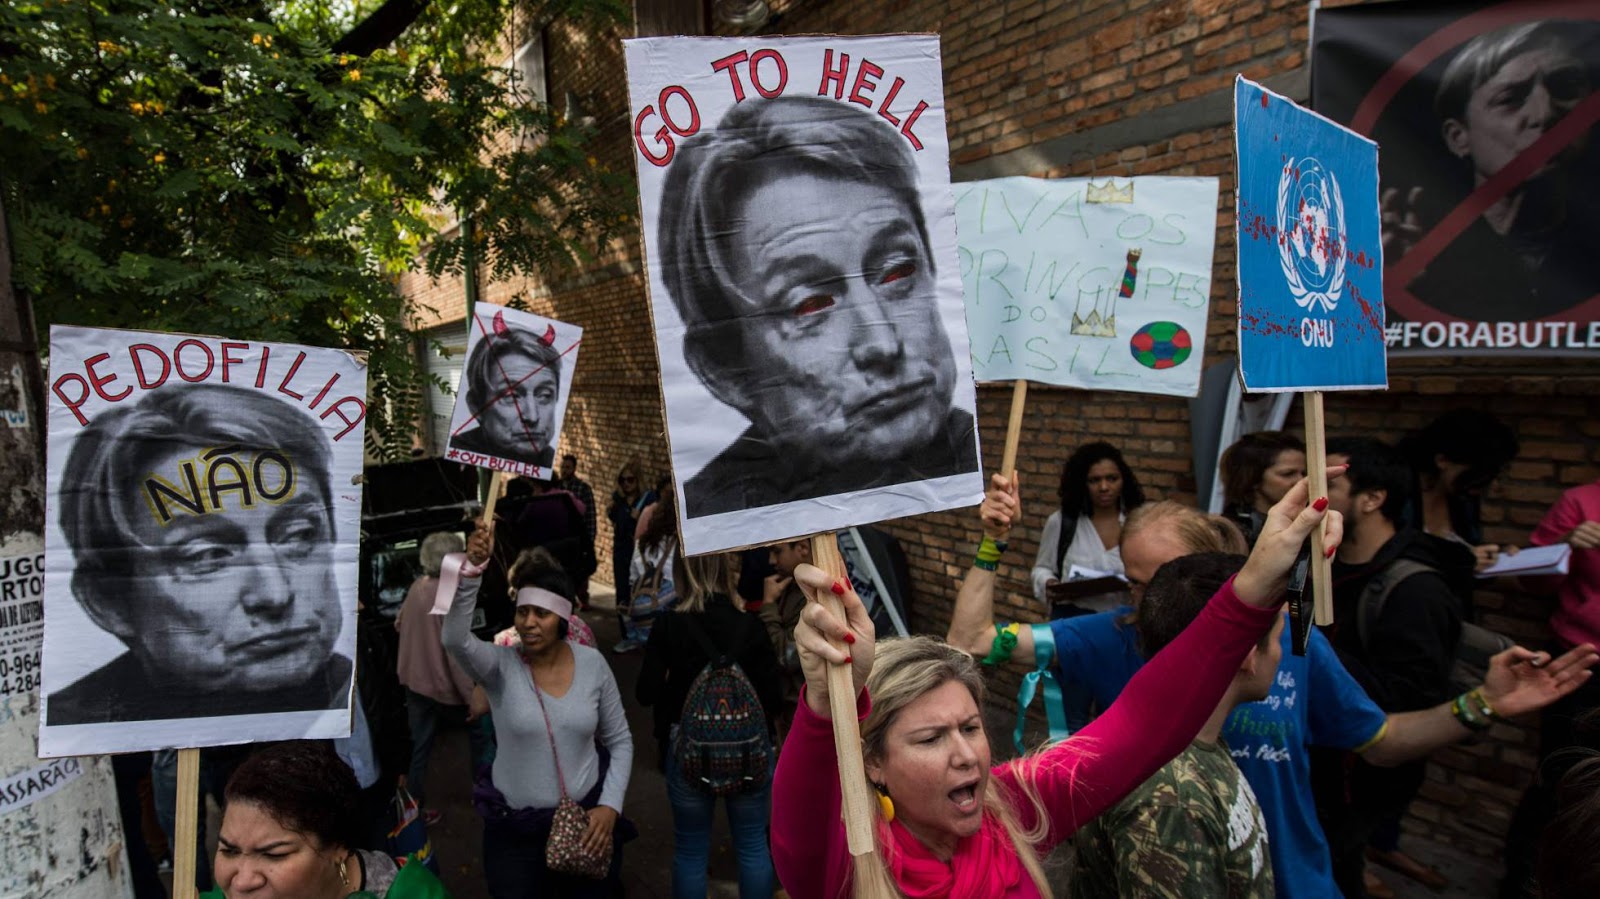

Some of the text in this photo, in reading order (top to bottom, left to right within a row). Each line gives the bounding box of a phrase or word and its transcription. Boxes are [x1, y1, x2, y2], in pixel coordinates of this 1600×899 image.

[634, 48, 930, 167] GO TO HELL
[1116, 213, 1187, 246] OS
[1003, 305, 1047, 323] DO
[1300, 317, 1335, 349] ONU
[51, 338, 367, 442] PEDOFILIA
[489, 455, 541, 478] BUTLER
[143, 444, 295, 526] NÃO
[1, 574, 45, 602] RTO
[0, 650, 43, 679] 0-964
